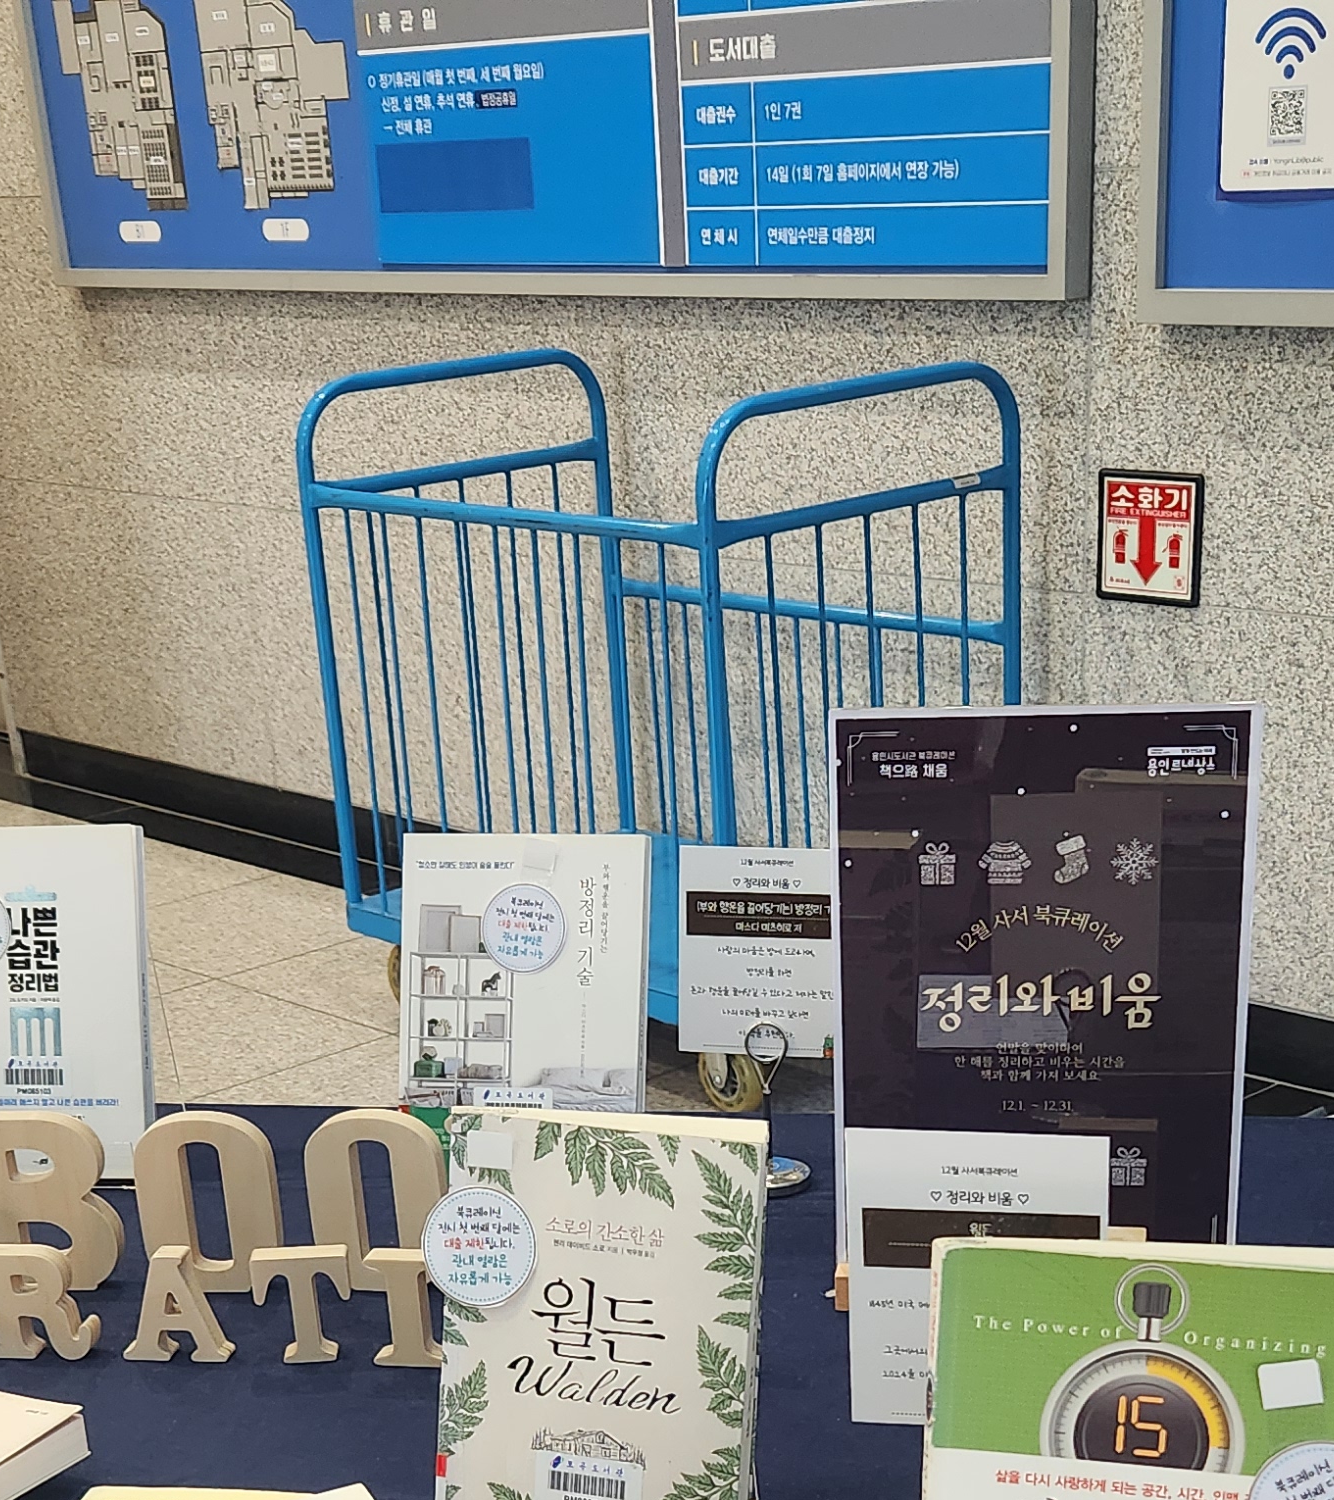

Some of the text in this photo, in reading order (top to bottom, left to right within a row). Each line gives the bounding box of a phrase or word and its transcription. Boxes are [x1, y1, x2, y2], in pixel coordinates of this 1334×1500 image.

[708, 34, 776, 62] 도서대출
[696, 102, 802, 124] 대출권수 1인 7권
[699, 159, 959, 186] 대출기간 14일 (1회 7일 홈페이지에서 연장 가능)
[767, 226, 875, 245] 연체일수만큼 대출정지
[1111, 485, 1187, 510] 소화기
[1130, 508, 1186, 518] EXTINGUISHER
[923, 764, 948, 779] 채움
[6, 906, 58, 937] 나쁜
[577, 876, 596, 987] 방정리 기술
[954, 904, 1125, 954] 12월 사서 북큐레이션
[7, 943, 60, 970] 습관
[7, 973, 59, 993] 정리법
[919, 972, 1161, 1033] 정리와 비움
[545, 1216, 665, 1247] 소로의 간소한 삶
[532, 1277, 665, 1367] 월든
[974, 1314, 1328, 1358] The Power of Organizing
[507, 1355, 682, 1416] Walden
[1114, 1393, 1168, 1459] 15
[995, 1470, 1020, 1486] 삶을
[1024, 1471, 1049, 1488] 다시
[1055, 1473, 1105, 1494] 사랑하게
[1110, 1480, 1137, 1497] 되는
